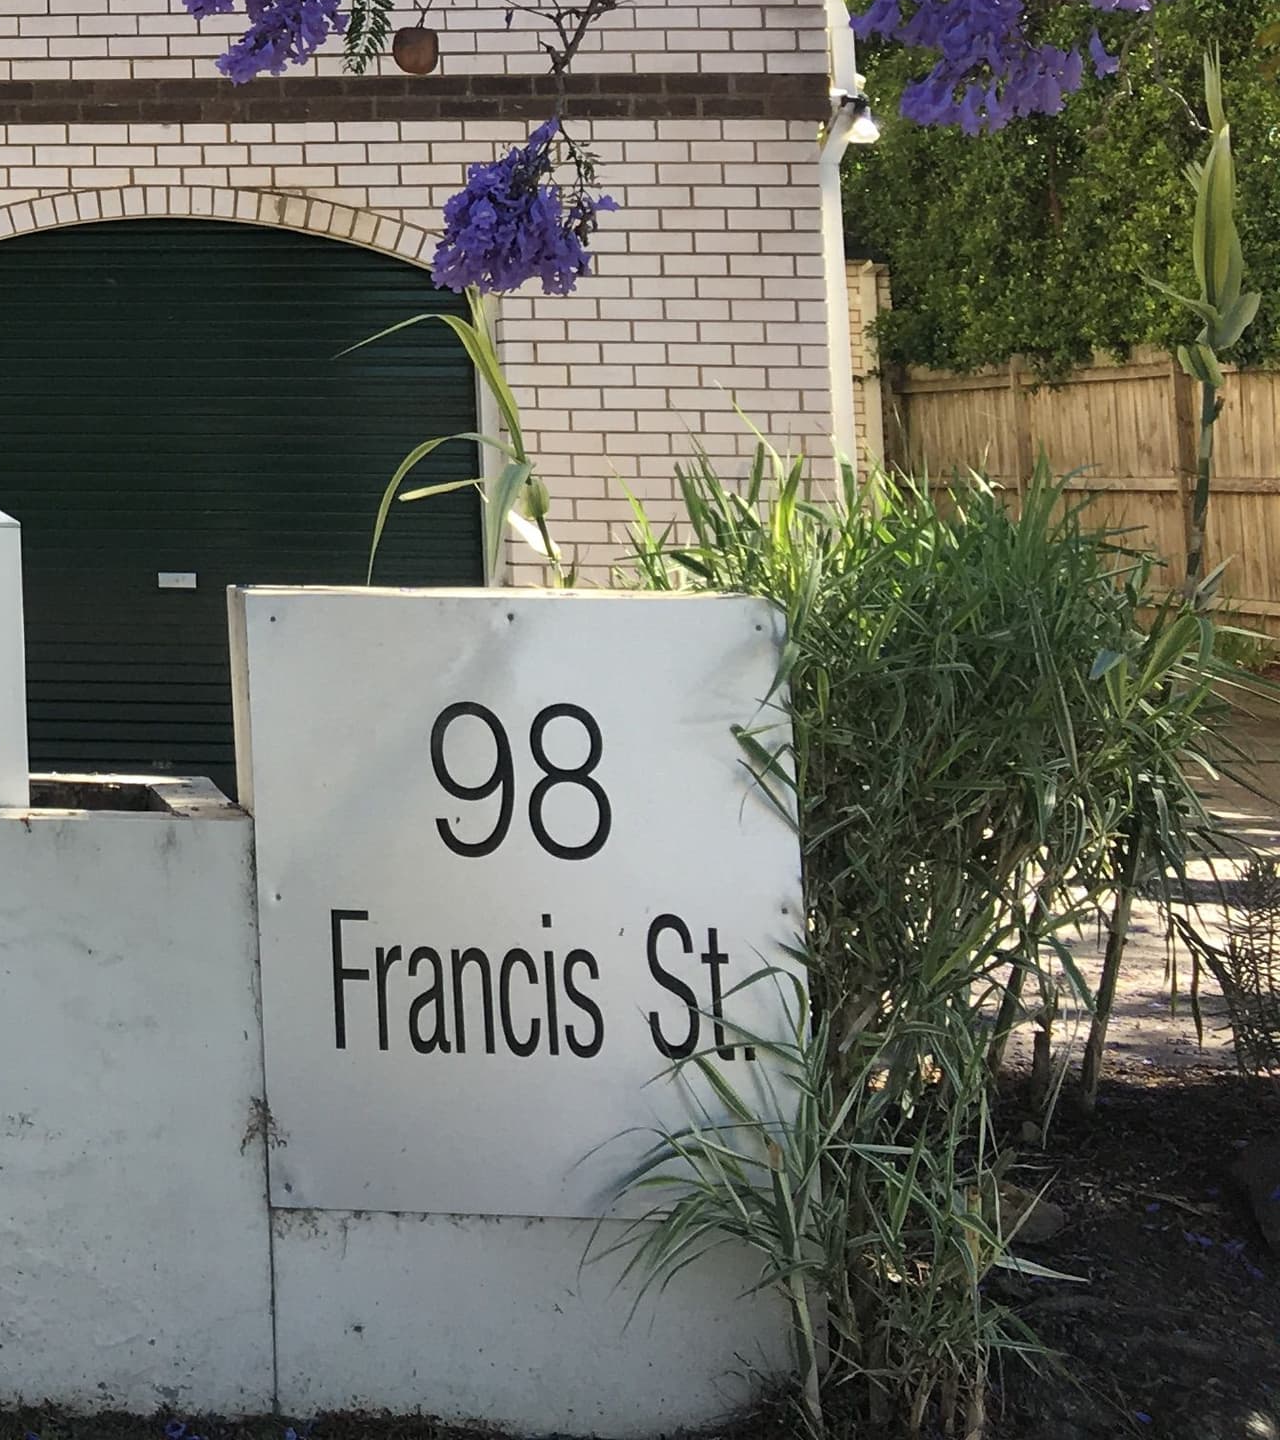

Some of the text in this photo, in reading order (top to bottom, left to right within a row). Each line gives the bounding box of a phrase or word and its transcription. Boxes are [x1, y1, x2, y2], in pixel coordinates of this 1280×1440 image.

[430, 701, 612, 861] 98
[330, 908, 756, 1062] Francis St.
